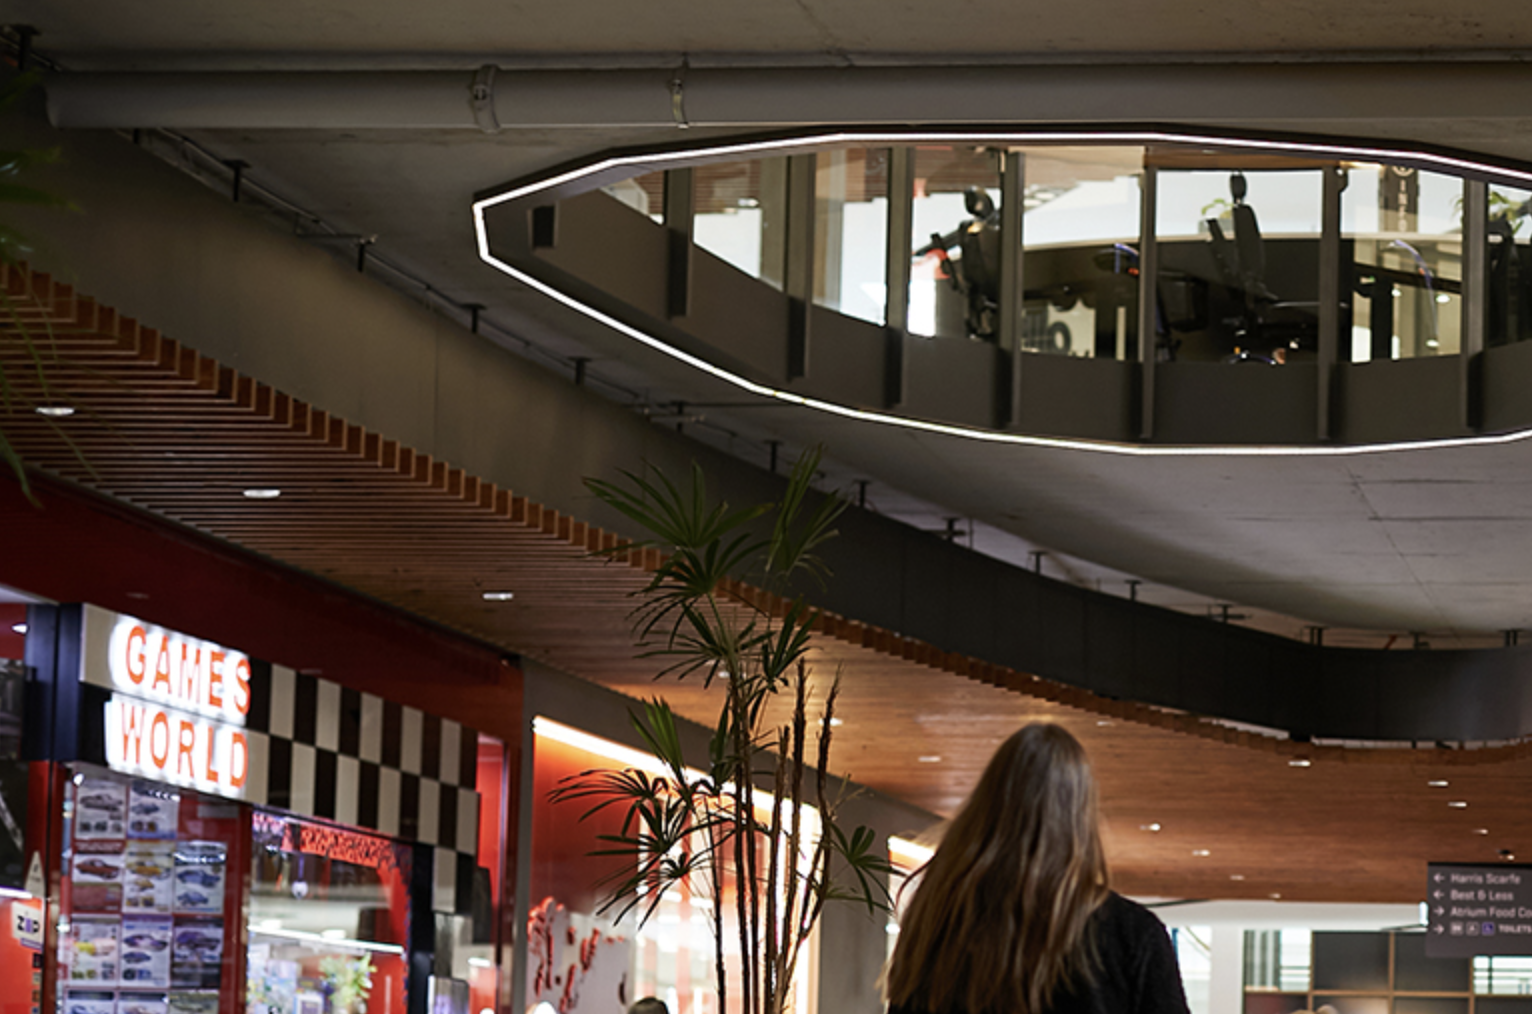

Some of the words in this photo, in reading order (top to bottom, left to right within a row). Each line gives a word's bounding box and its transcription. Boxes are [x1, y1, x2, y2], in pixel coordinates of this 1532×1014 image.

[125, 624, 252, 716] GAMES
[121, 702, 249, 789] WORLD
[1450, 873, 1484, 885] Harris
[1486, 873, 1521, 886] Scarfe
[1450, 890, 1475, 901] Best
[1477, 890, 1486, 901] &
[1489, 890, 1514, 901] Less
[1450, 907, 1487, 918] Atrium
[1489, 907, 1516, 918] Food
[1498, 924, 1532, 934] TOILETS
